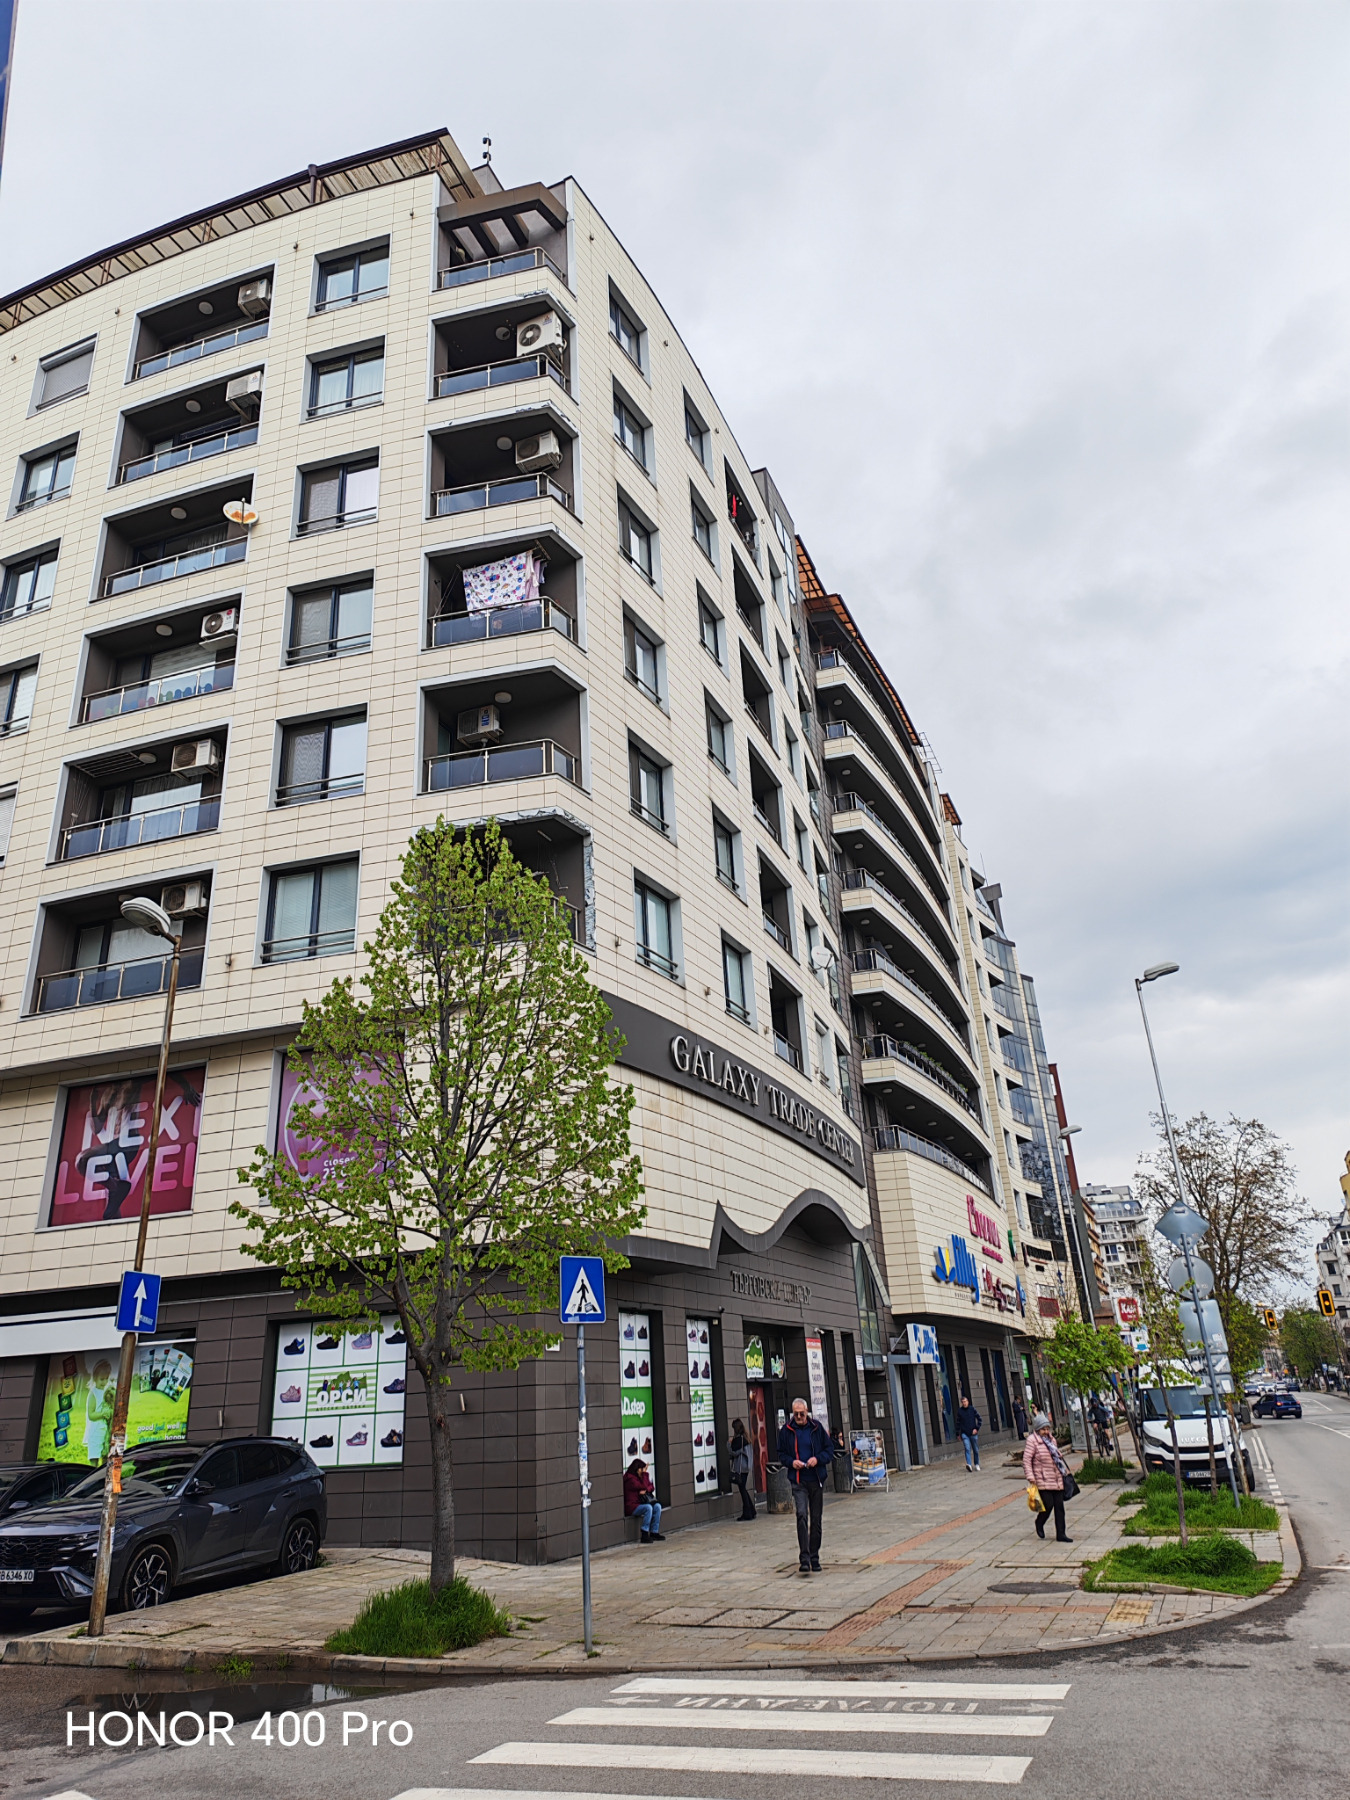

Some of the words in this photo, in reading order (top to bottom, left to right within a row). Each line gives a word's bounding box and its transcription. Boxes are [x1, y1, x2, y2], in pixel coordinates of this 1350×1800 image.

[670, 1035, 760, 1106] GALAXY
[768, 1084, 817, 1138] TRADE
[818, 1118, 855, 1167] CENTER
[316, 1388, 367, 1407] ОРСИ
[1181, 1436, 1208, 1444] IVECO
[673, 1696, 980, 1714] ПОГЛЕДНИ
